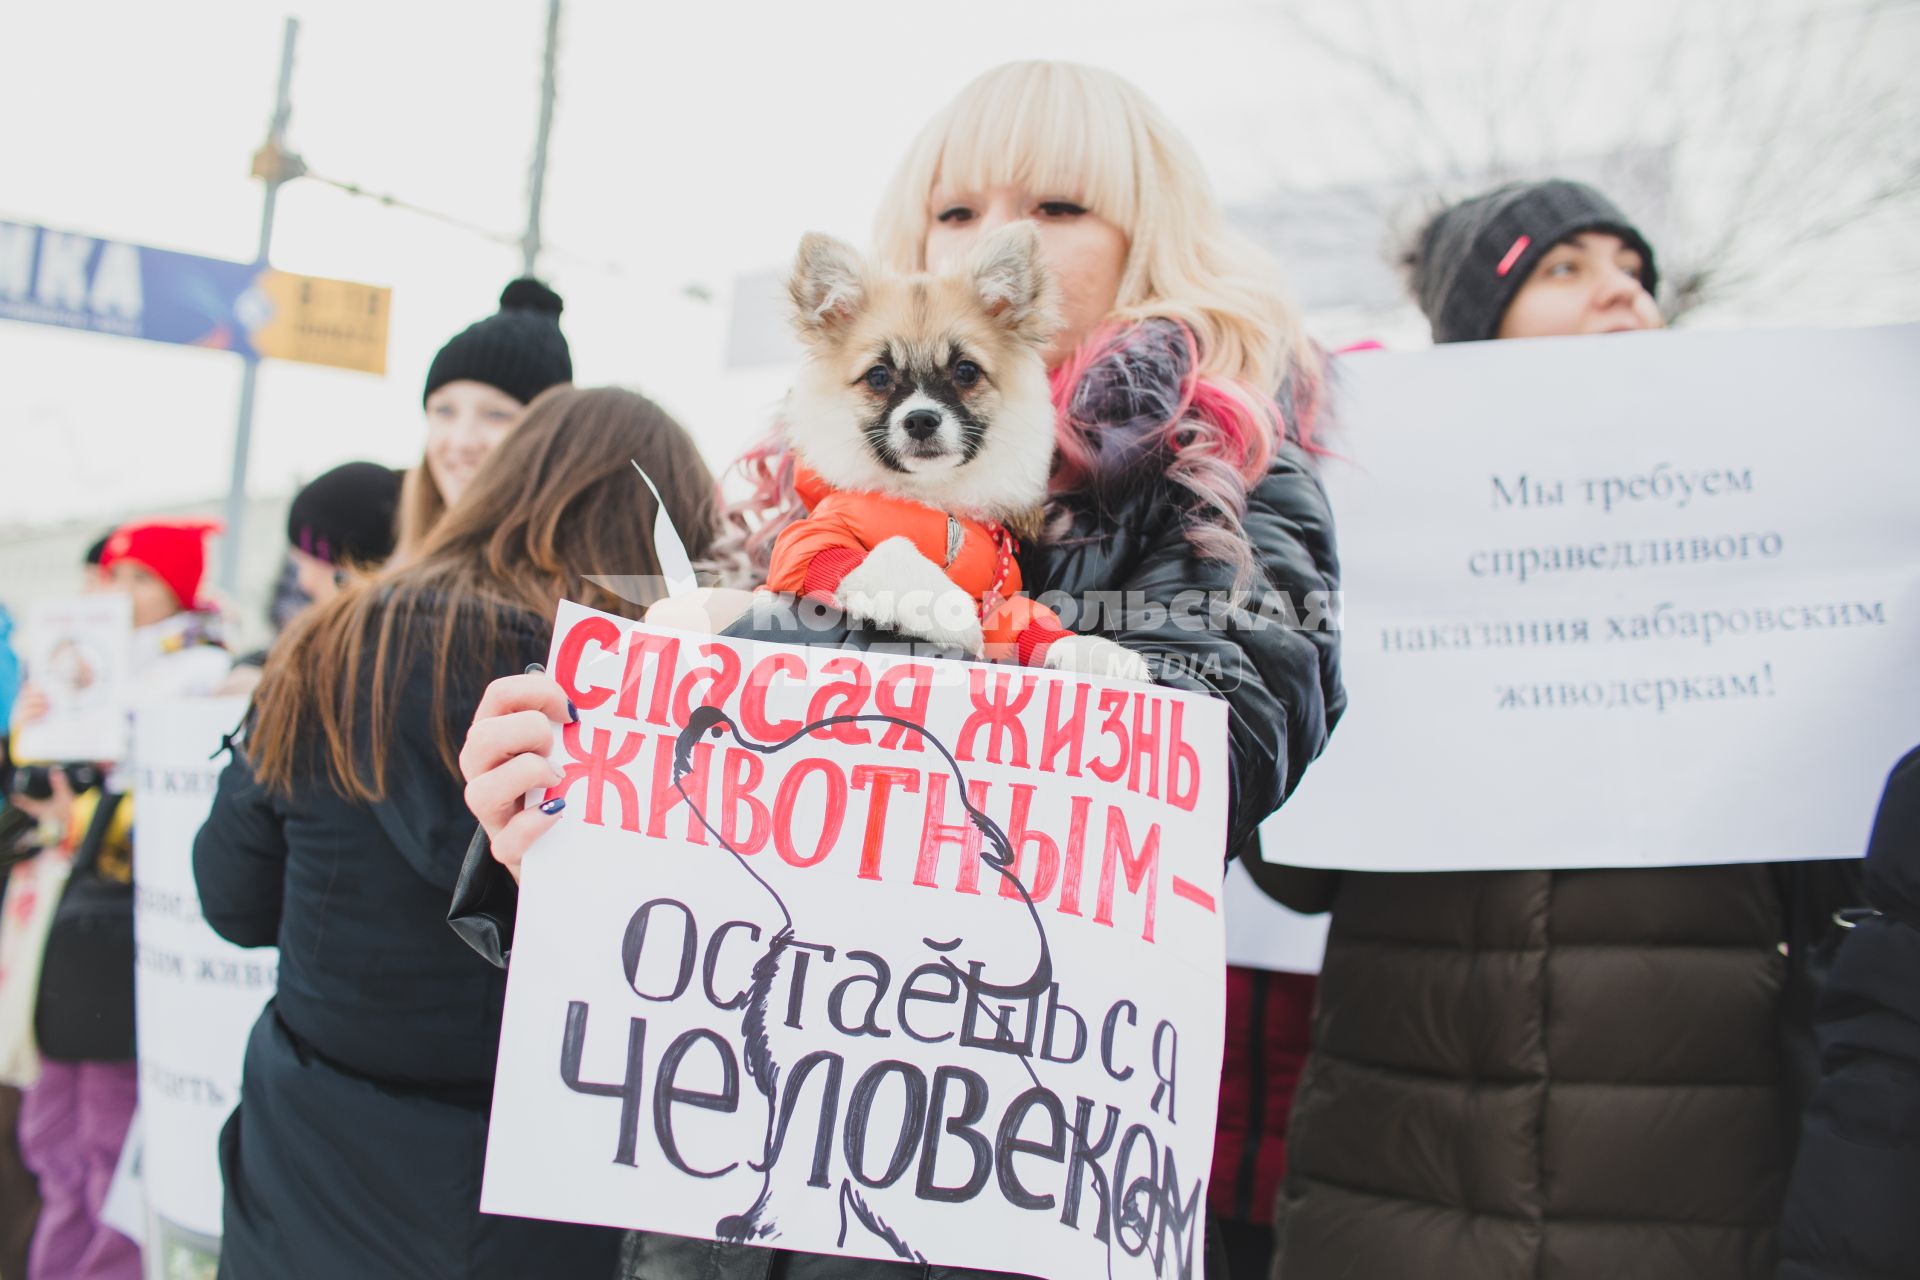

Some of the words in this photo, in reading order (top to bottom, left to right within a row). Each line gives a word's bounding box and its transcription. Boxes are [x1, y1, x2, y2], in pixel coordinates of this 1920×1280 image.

[1491, 473, 1564, 510] Мы
[1583, 463, 1754, 512] требуем
[1468, 528, 1783, 584] справедливого
[1381, 613, 1590, 653] наказания
[1605, 600, 1888, 646] хабаровским
[1496, 662, 1777, 714] живодеркам!
